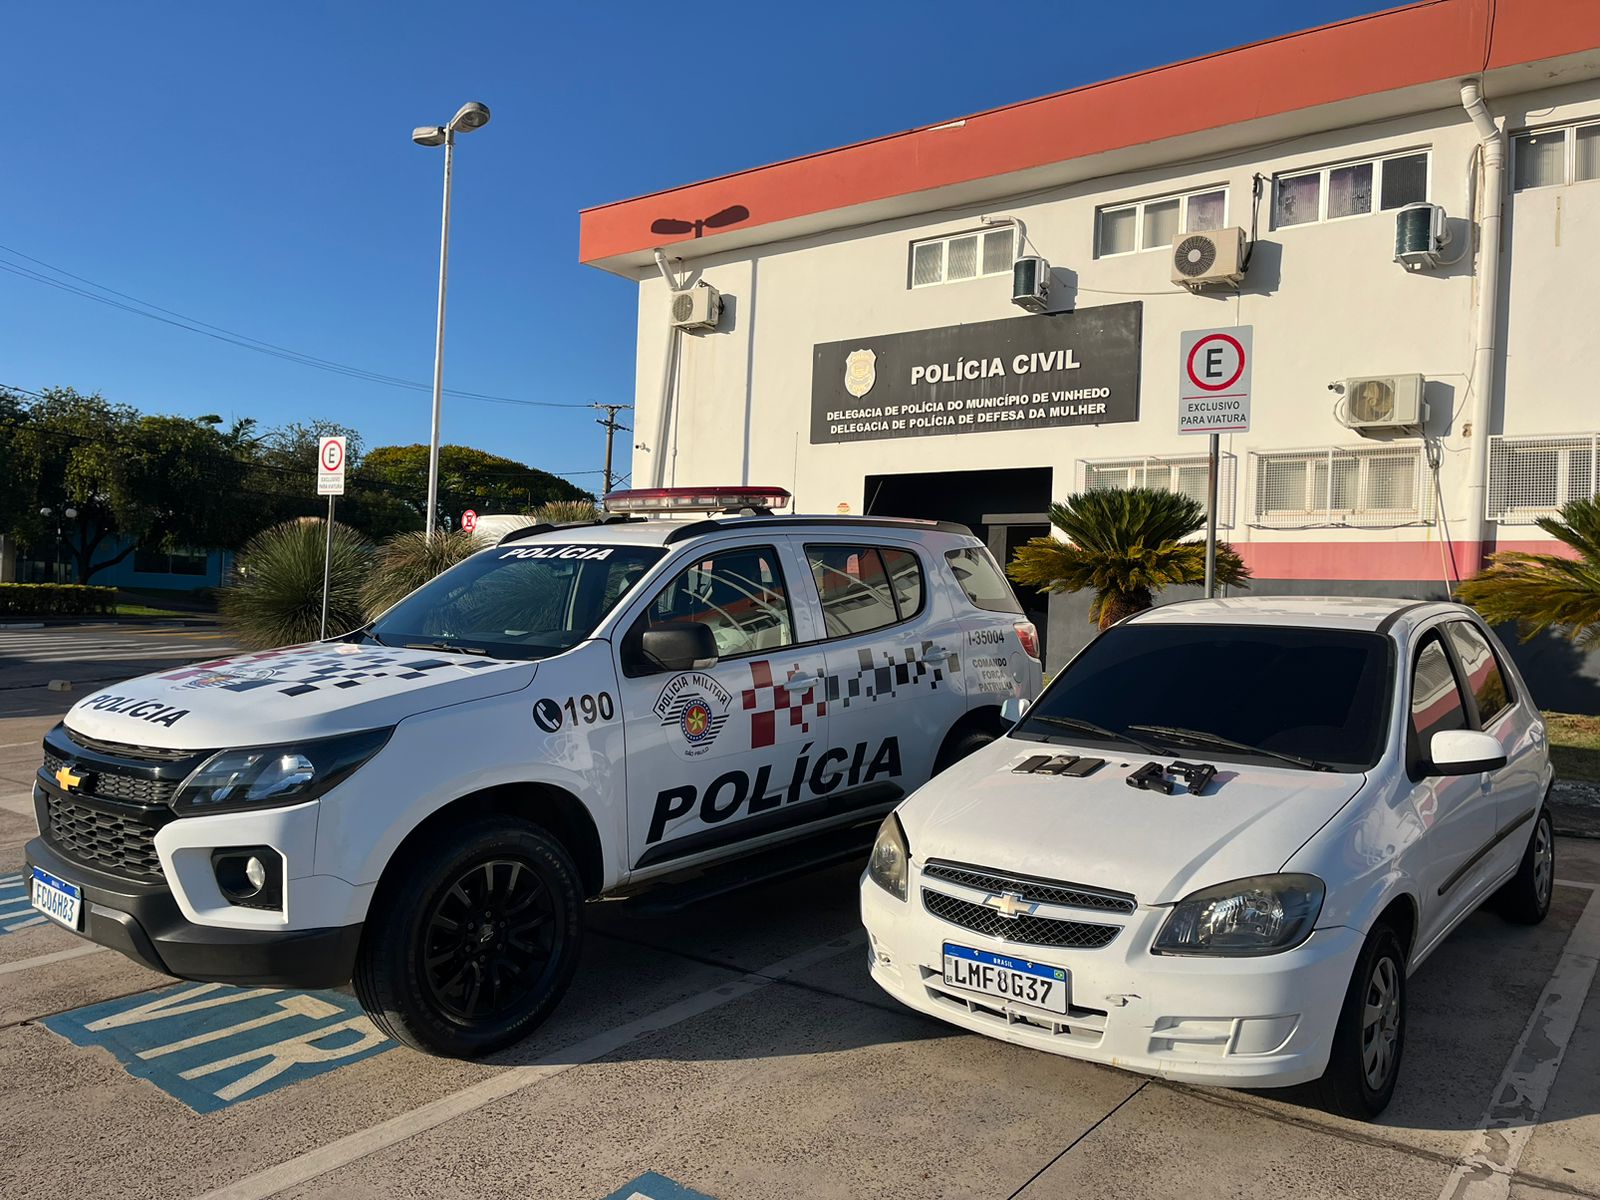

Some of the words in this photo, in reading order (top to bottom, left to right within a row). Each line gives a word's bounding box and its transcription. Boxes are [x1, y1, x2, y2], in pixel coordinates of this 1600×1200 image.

[911, 356, 1005, 385] POLÍCIA
[1013, 349, 1081, 375] CIVIL
[1206, 348, 1223, 377] E
[827, 408, 882, 421] DELEGACIA
[885, 406, 899, 416] DE
[901, 401, 944, 415] POLÍCIA
[947, 400, 963, 411] DO
[966, 394, 1029, 409] MUNICÍPIO
[1032, 392, 1049, 403] DE
[1051, 387, 1110, 402] VINHEDO
[830, 421, 889, 434] DELEGACIA
[892, 419, 906, 430] DE
[909, 414, 955, 428] POLÍCIA
[958, 414, 974, 425] DE
[977, 410, 1025, 423] DEFESA
[1029, 408, 1046, 419] DA
[1050, 403, 1106, 417] MULHER
[1181, 416, 1205, 425] PARA
[1207, 413, 1246, 424] VIATURA
[1188, 401, 1240, 412] EXCLUSIVO
[329, 447, 335, 463] E
[499, 545, 614, 560] POLÍCIA
[968, 630, 1005, 646] I-35004
[972, 657, 1007, 668] COMANDO
[693, 675, 728, 705] MILITAR
[80, 694, 190, 728] POLÍCIA
[564, 691, 614, 727] 190
[646, 736, 903, 845] POLÍCIA
[993, 957, 1014, 968] BRASIL
[954, 960, 1053, 1004] LMF8G37
[84, 983, 390, 1101] VTR
